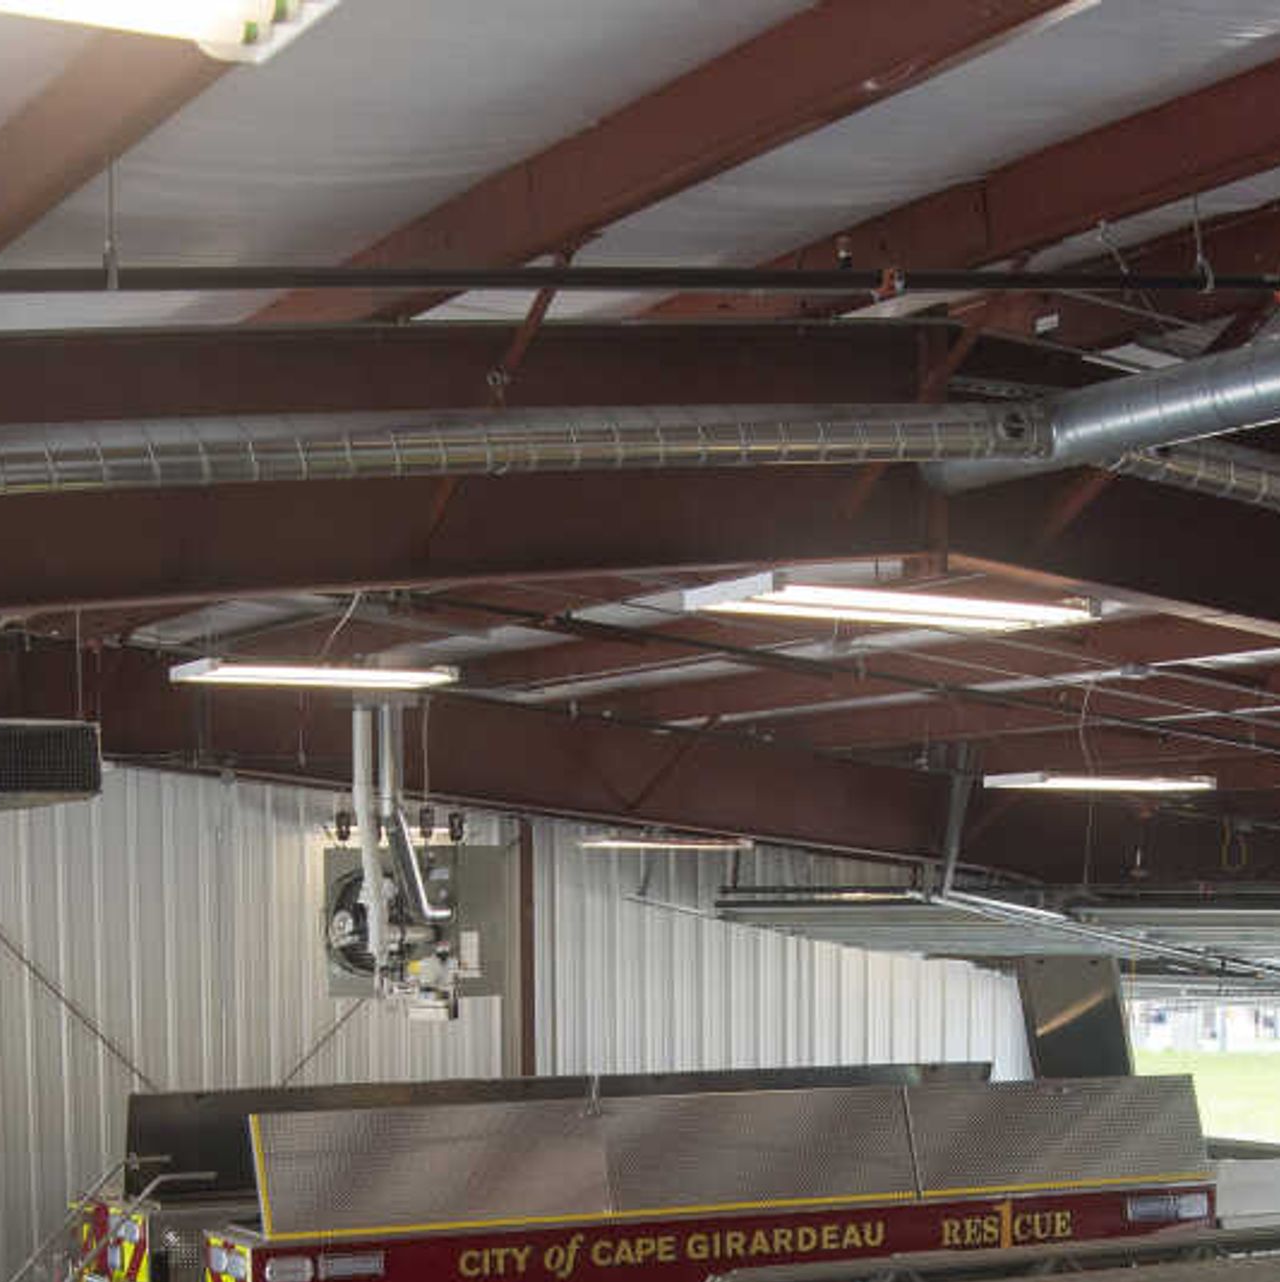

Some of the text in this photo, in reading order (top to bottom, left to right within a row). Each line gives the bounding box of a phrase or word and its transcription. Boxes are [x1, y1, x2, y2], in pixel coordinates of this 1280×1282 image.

[458, 1219, 886, 1279] CITY of CAPE GIRARDEAU
